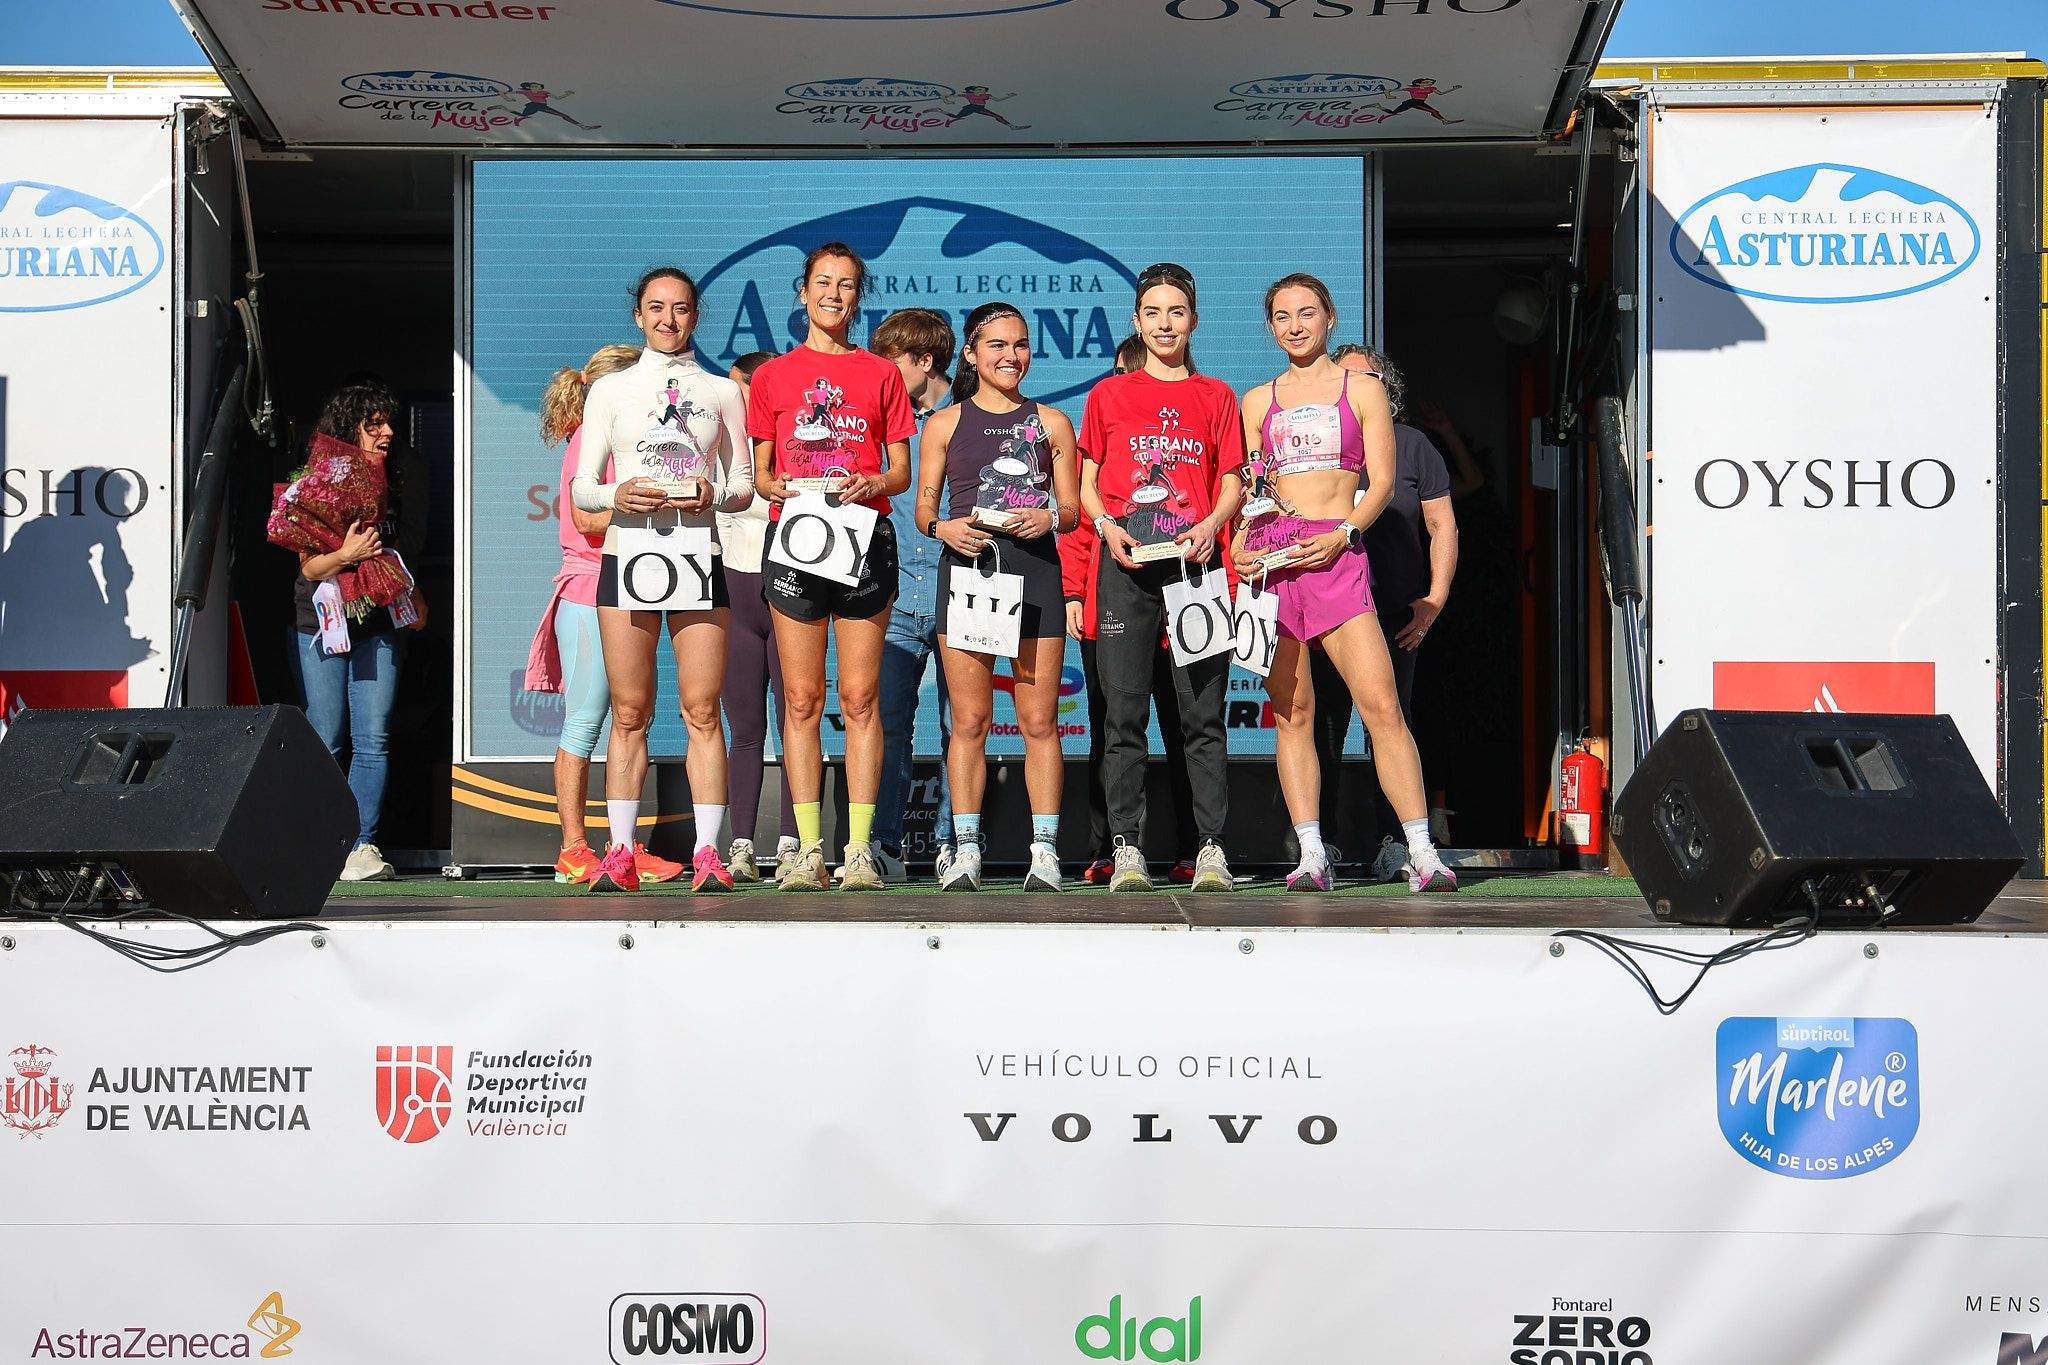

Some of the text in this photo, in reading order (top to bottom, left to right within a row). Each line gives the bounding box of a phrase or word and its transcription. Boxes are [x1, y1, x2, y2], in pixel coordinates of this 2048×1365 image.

[358, 78, 499, 94] ASTURIANA
[800, 86, 942, 97] ASTURIANA
[1243, 83, 1387, 94] ASTURIANA
[338, 95, 479, 112] Carrera
[775, 101, 914, 115] Carrera
[1213, 98, 1353, 112] Carrera
[380, 109, 528, 131] de la Mujer
[812, 112, 957, 133] de la Mujer
[1245, 108, 1395, 128] de la Mujer
[1741, 211, 1947, 225] CENTRAL LECHERA
[43, 227, 134, 238] LECHERA
[1692, 214, 1958, 266] ASTURIANA
[957, 274, 1105, 294] LECHERA
[0, 467, 149, 518] SHO
[1694, 458, 1956, 509] OYSHO
[467, 1049, 592, 1068] Fundación
[975, 1049, 1322, 1079] VEHÍCULO OFICIAL
[88, 1067, 313, 1093] AJUNTAMENT
[467, 1072, 588, 1095] Deportiva
[1729, 1051, 1908, 1136] Marlene
[86, 1097, 312, 1131] DE VALÈNCIA
[467, 1095, 585, 1118] Municipal
[467, 1118, 568, 1136] València
[963, 1111, 1339, 1146] VOLVO
[1739, 1132, 1895, 1172] HIJA DE LOS ALPES
[1551, 1297, 1613, 1312] Fontarel
[1965, 1295, 2048, 1314] MENS
[622, 1302, 754, 1355] COSMO
[1075, 1293, 1202, 1363] dial
[31, 1328, 250, 1359] AstraZeneca
